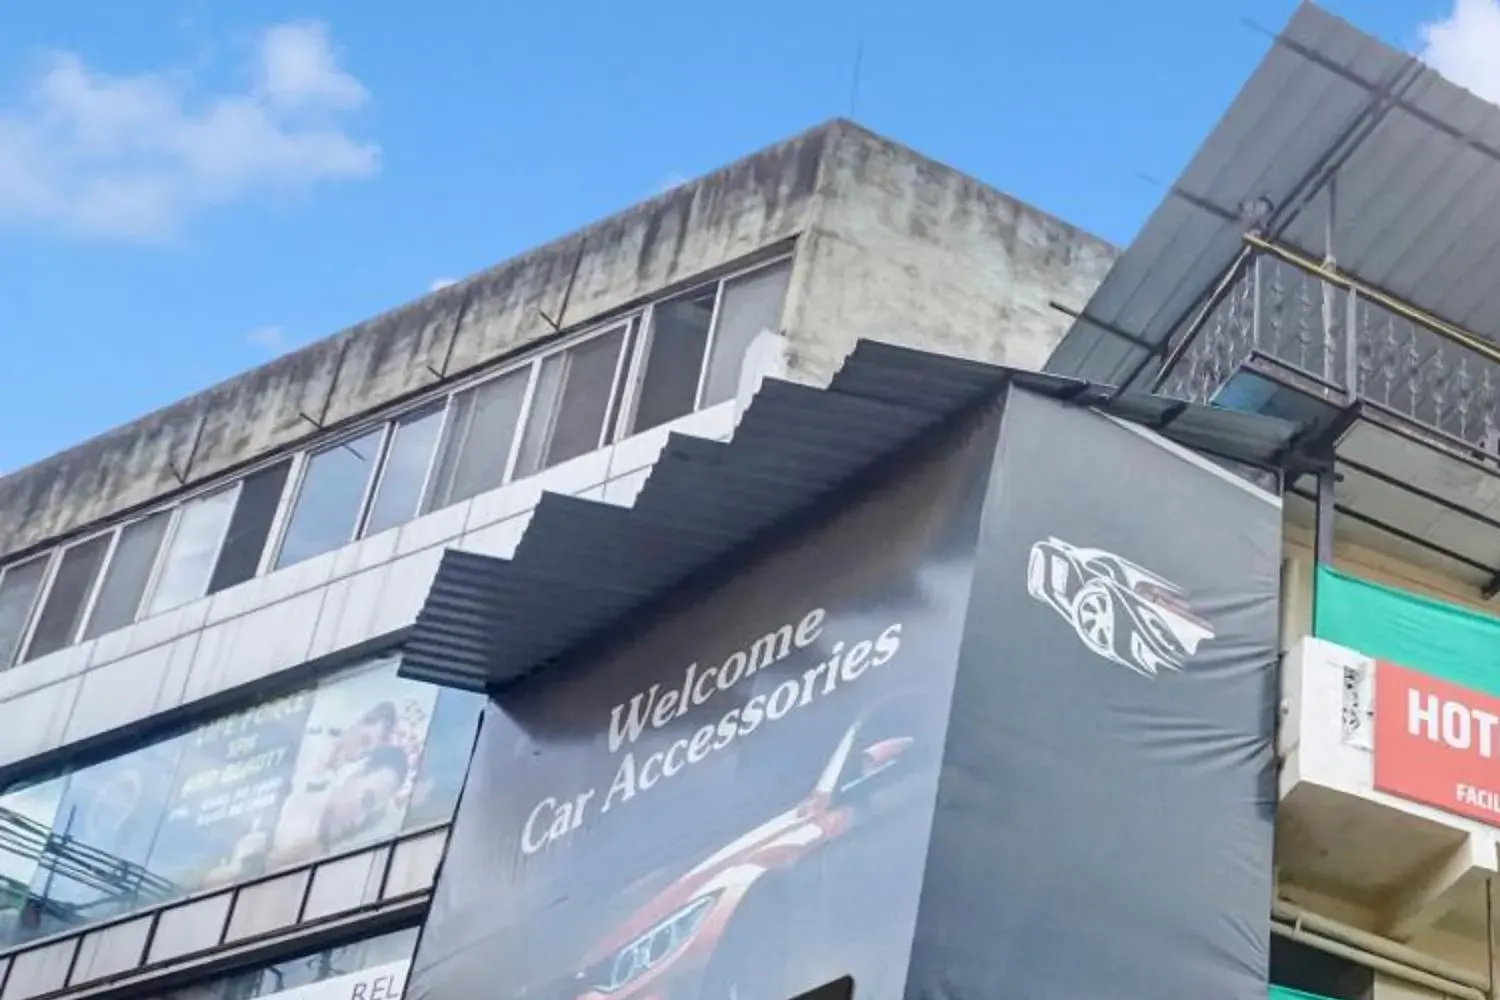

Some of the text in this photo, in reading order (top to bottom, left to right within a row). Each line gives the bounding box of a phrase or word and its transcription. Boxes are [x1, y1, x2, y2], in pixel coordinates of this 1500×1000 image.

[521, 623, 902, 854] Car Accessories
[608, 608, 826, 753] Welcome
